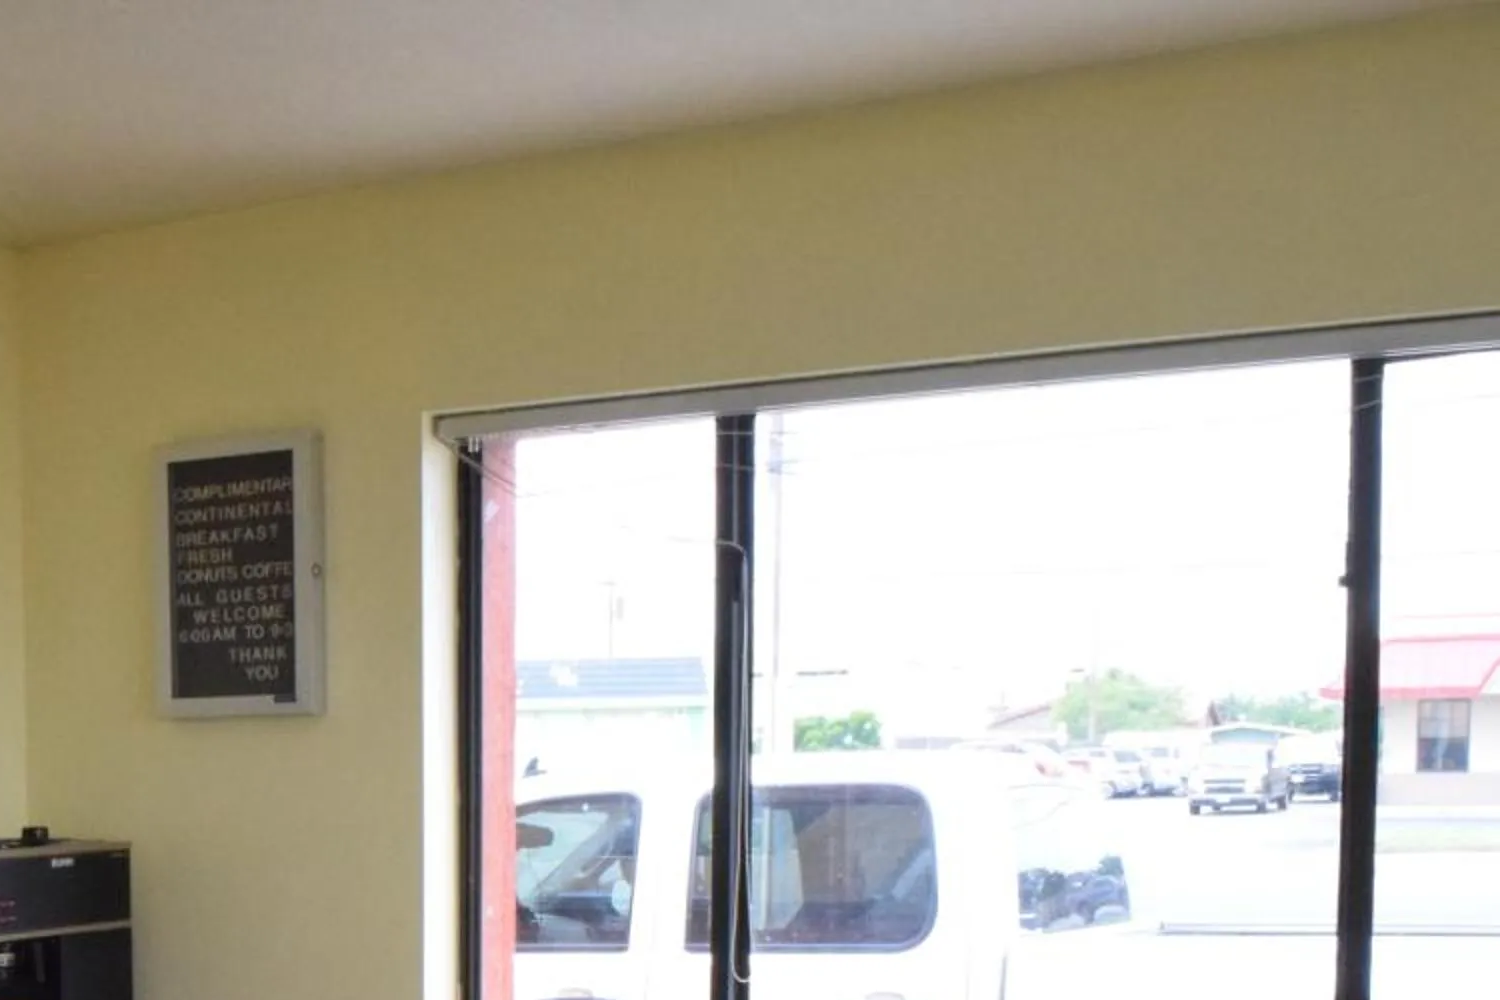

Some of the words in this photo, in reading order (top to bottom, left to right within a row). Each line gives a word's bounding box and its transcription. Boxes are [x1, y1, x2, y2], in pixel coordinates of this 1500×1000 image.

[176, 523, 278, 547] BREAKFAST
[178, 547, 233, 566] FRESH
[177, 565, 238, 584] DONUTS
[178, 591, 204, 606] ALL
[216, 584, 292, 603] GUESTS
[193, 604, 285, 623] WELCOME
[244, 623, 265, 640] TO
[229, 645, 287, 663] THANK
[244, 664, 279, 682] YOU
